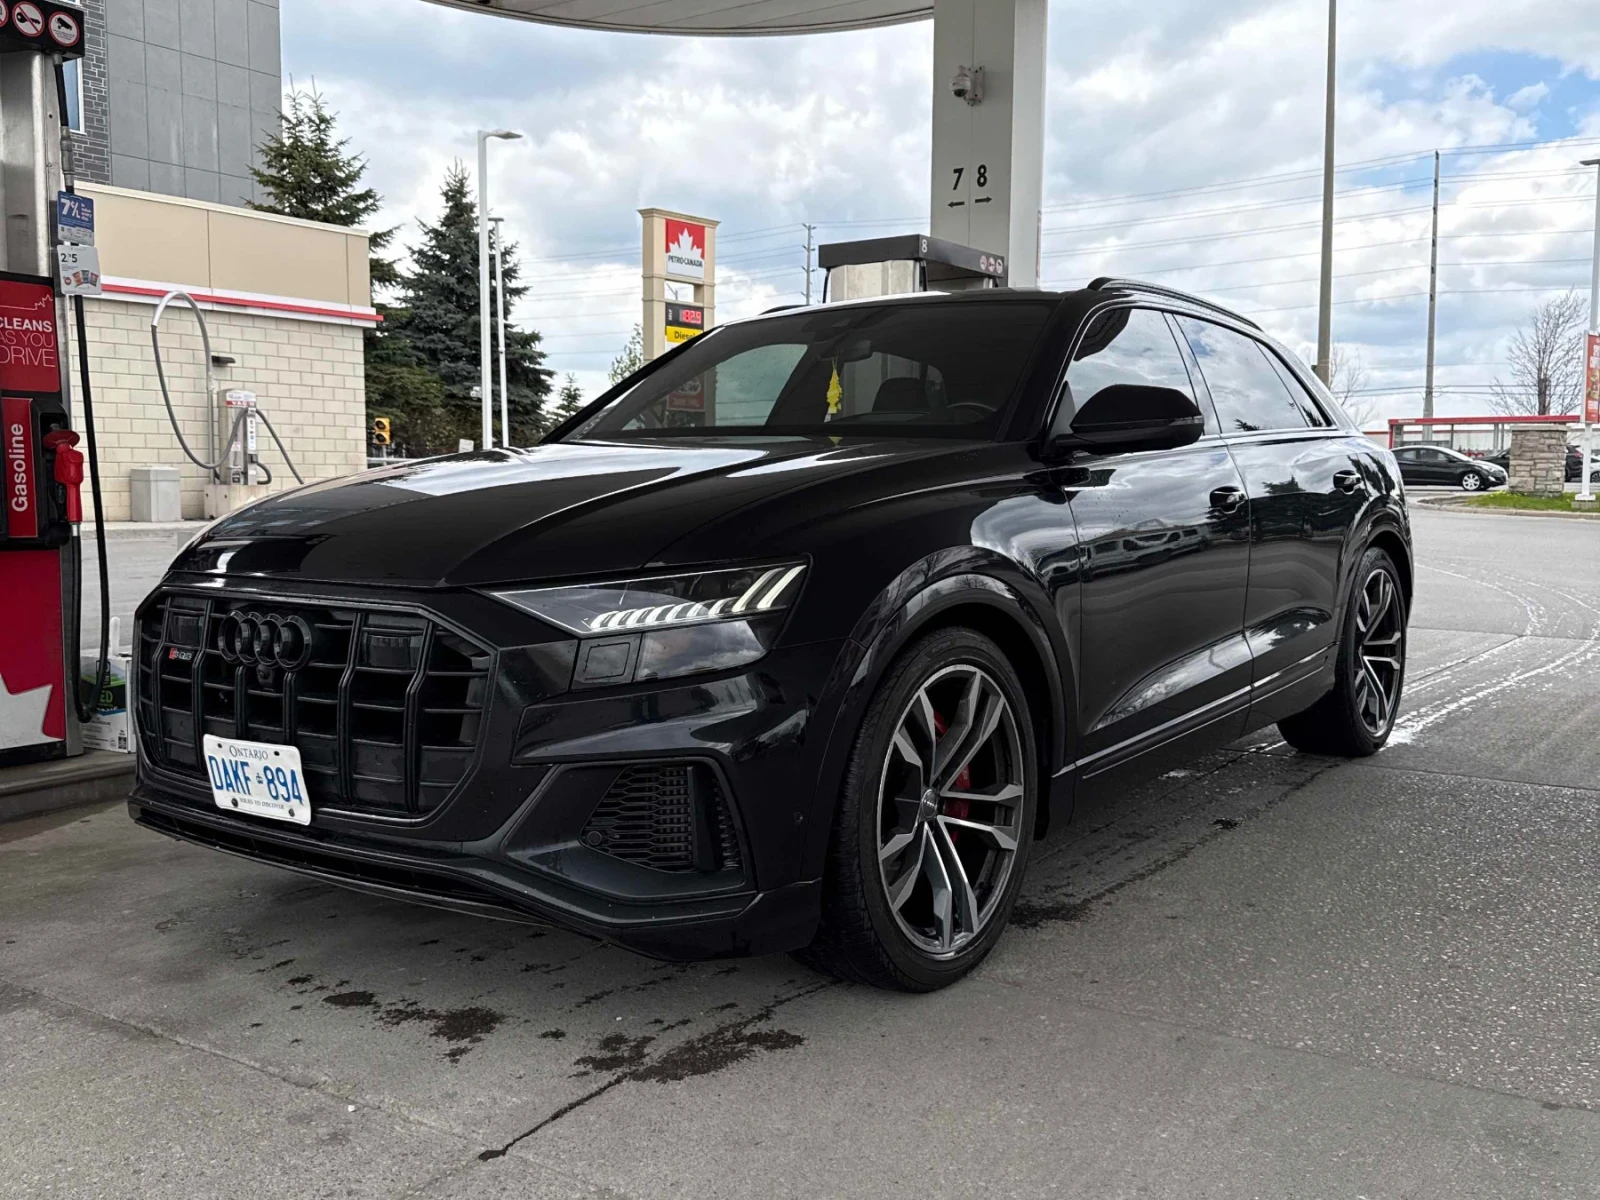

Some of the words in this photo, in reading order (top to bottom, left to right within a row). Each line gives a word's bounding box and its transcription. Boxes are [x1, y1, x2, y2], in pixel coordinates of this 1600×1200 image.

[953, 167, 964, 190] 7
[976, 164, 987, 187] 8
[921, 239, 928, 253] 8
[19, 332, 54, 348] YOU
[0, 344, 56, 368] DRIVE
[9, 423, 29, 512] Gasoline
[229, 745, 268, 761] ONTARIO
[208, 755, 251, 796] DAKF
[263, 765, 304, 806] 894
